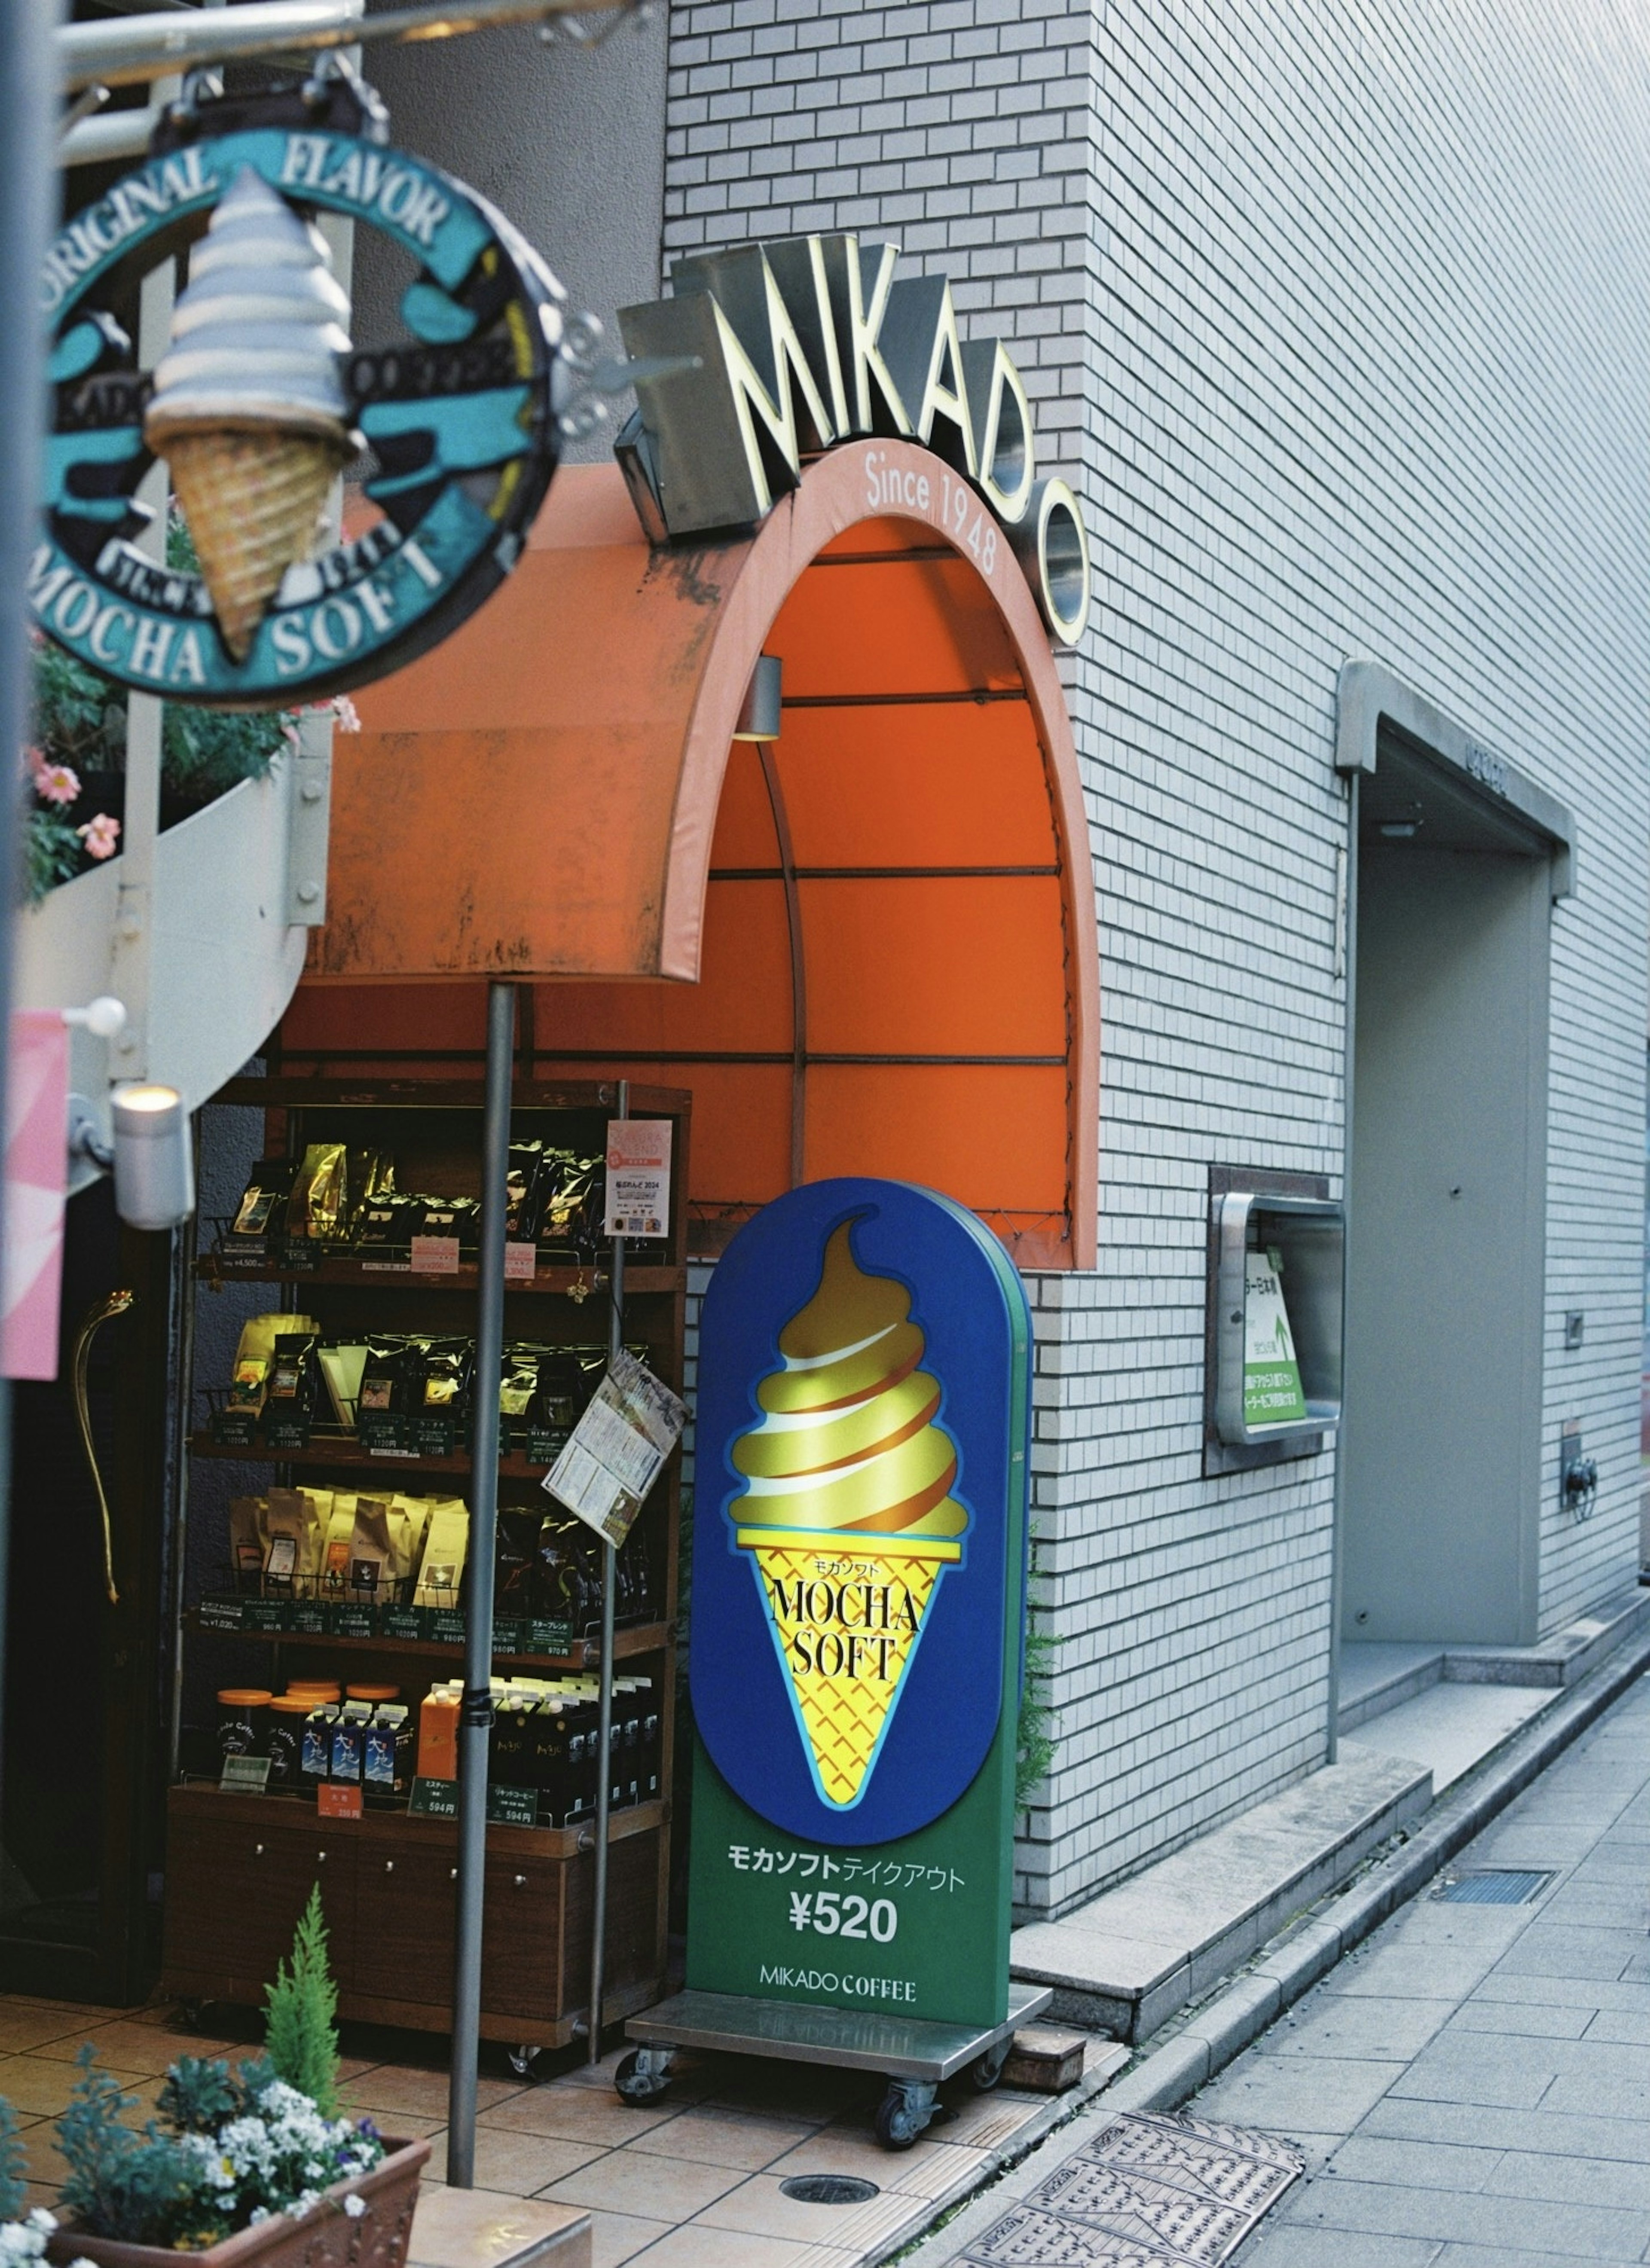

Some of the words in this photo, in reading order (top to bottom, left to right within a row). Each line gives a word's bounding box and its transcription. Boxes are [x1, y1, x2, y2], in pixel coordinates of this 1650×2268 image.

[283, 135, 449, 245] FLAVOR
[707, 234, 1091, 647] MIKADO
[864, 451, 930, 510] Since
[942, 473, 997, 576] 1948
[28, 544, 208, 686] MOCHA
[272, 543, 444, 675] SOFT
[814, 1560, 880, 1577] モカソフト
[770, 1579, 922, 1633] MOCHA
[793, 1631, 896, 1681] SOFT
[335, 1732, 360, 1764] 大地
[367, 1736, 394, 1768] 大地
[429, 1801, 454, 1814] 594円
[506, 1810, 532, 1823] 594円
[728, 1845, 965, 1893] モカソフトテイクアウト
[789, 1890, 898, 1943] ¥520
[760, 1964, 838, 1992] MIKADO
[842, 1975, 917, 2002] COFFEE
